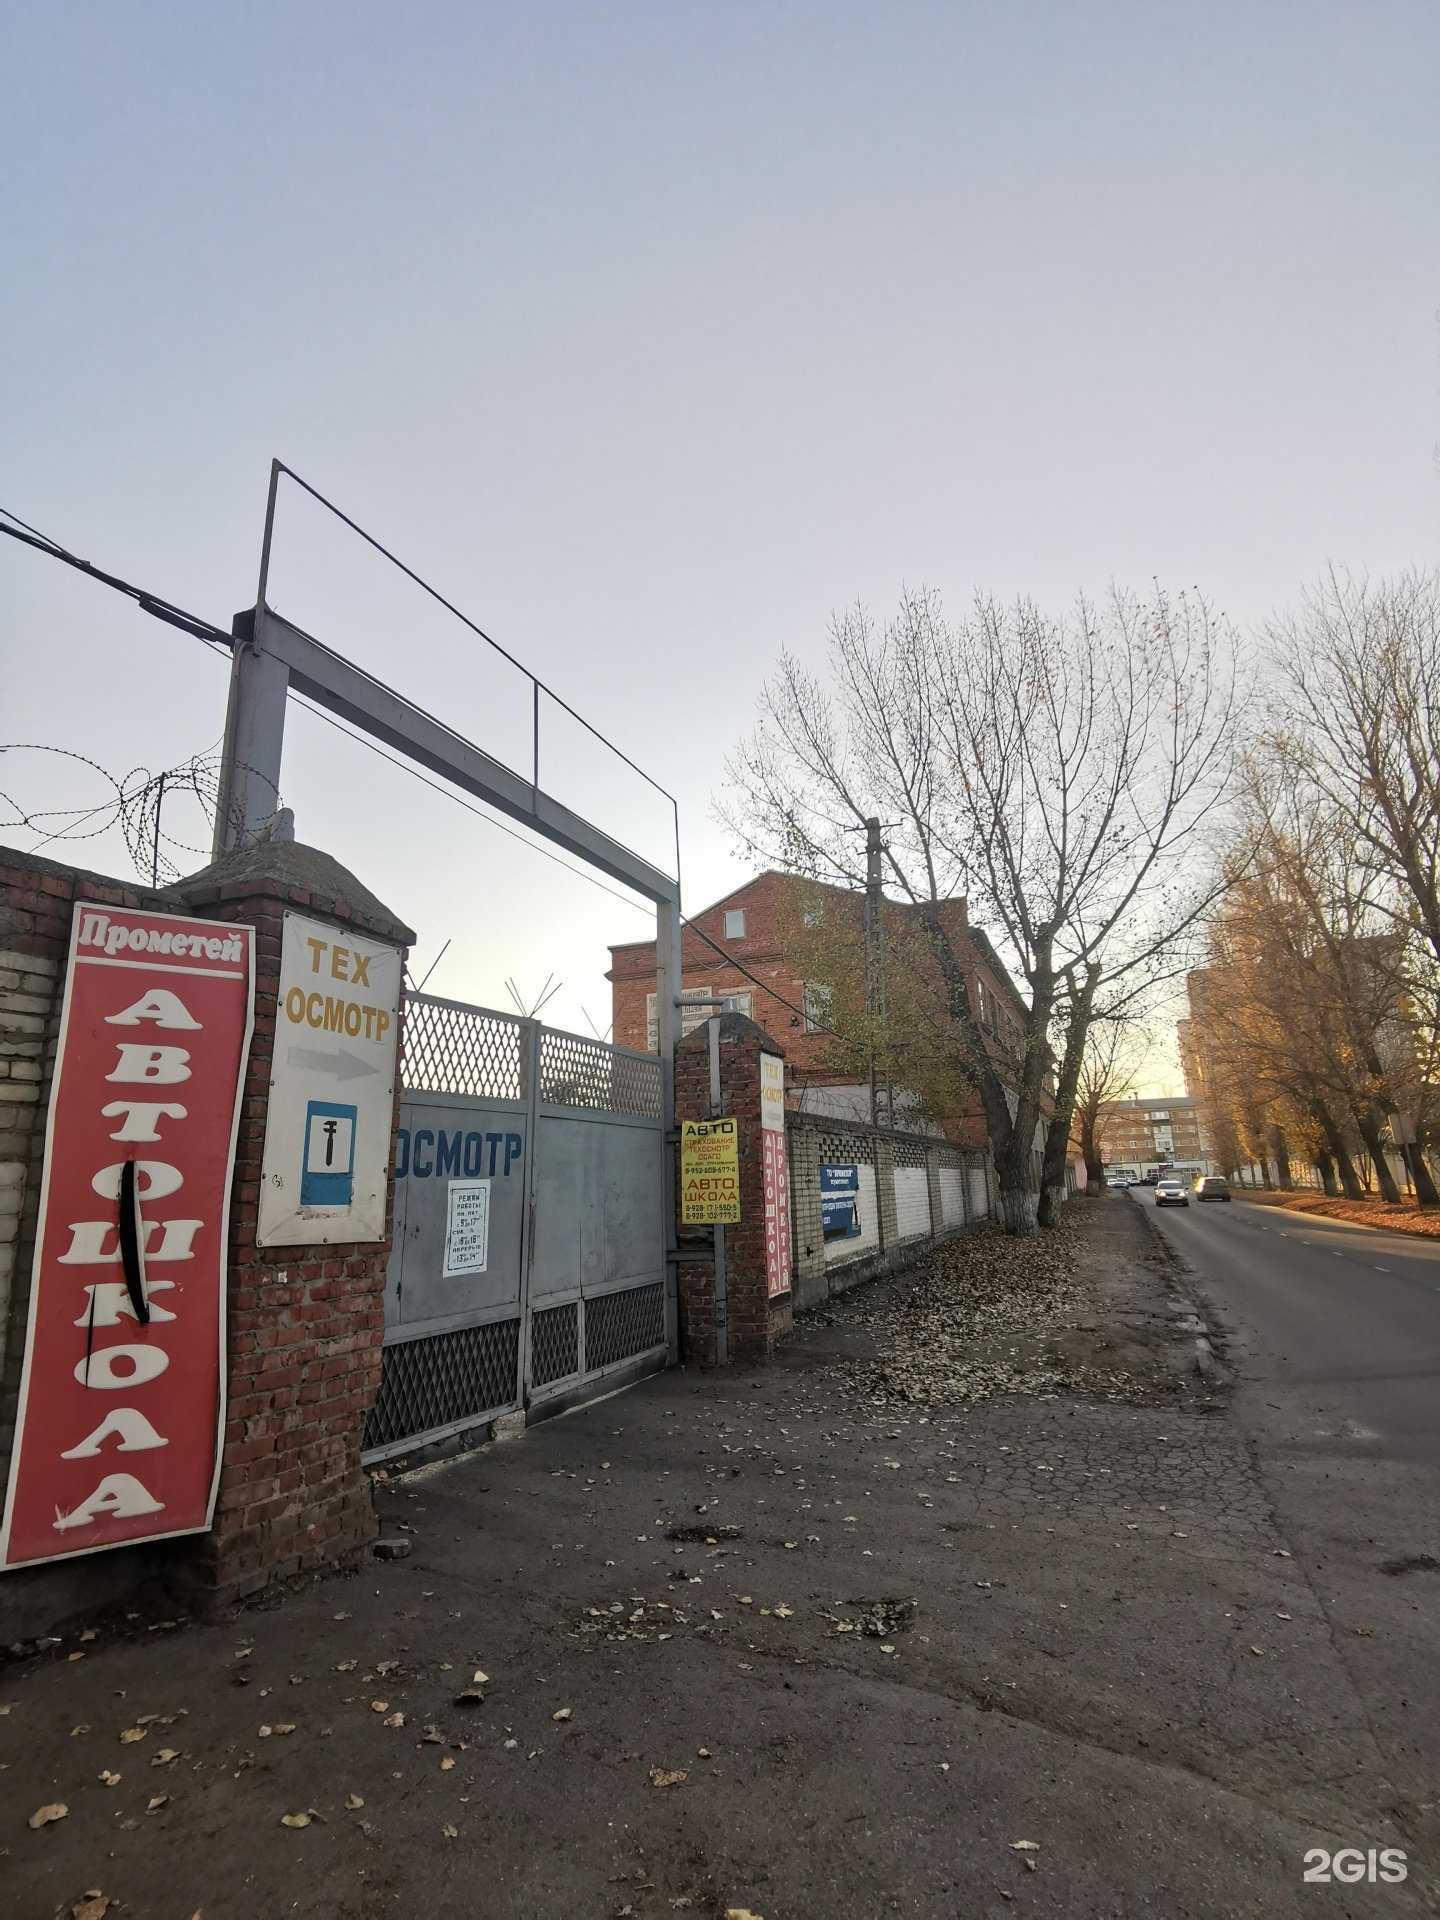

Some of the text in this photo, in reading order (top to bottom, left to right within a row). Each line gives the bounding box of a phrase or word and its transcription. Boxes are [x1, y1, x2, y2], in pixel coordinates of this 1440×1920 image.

[79, 913, 243, 962] Прометей
[307, 936, 372, 987] ТЕХ
[286, 986, 390, 1041] ОСМОТР
[685, 1136, 735, 1145] СТРАХОВАНИЕ
[686, 1122, 733, 1136] АВТО
[685, 1191, 737, 1202] ШКОЛА
[688, 1178, 735, 1190] АВТО
[765, 1133, 777, 1291] АВТОШКОЛА
[777, 1136, 788, 1286] ПРОМЕТЕЙ
[53, 988, 204, 1531] АВТОШКОЛА
